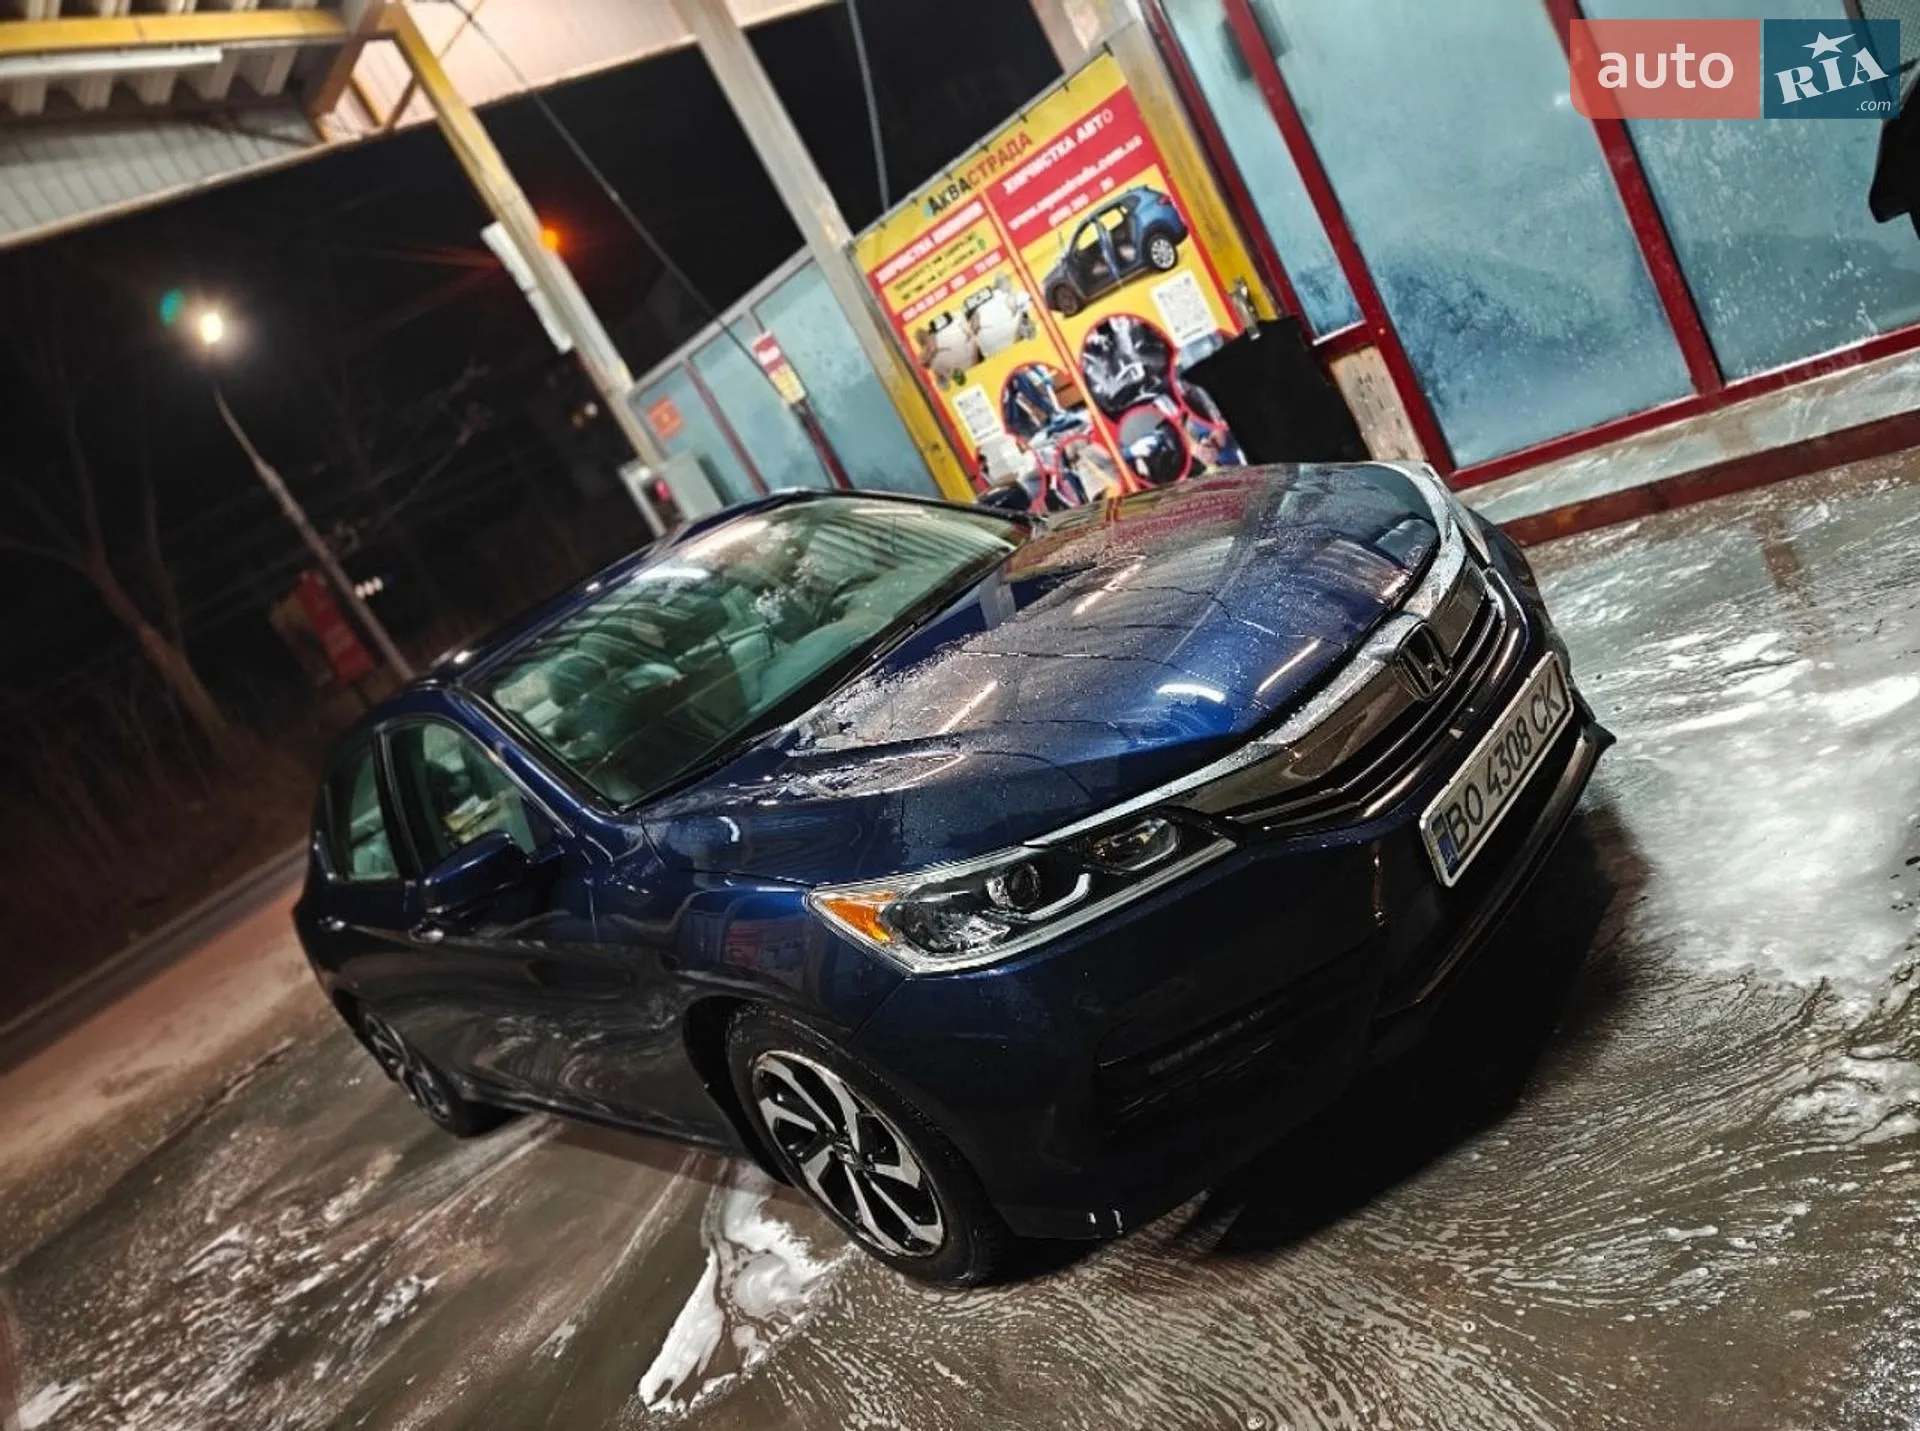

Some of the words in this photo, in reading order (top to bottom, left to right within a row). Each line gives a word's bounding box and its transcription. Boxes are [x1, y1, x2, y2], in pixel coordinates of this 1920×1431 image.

[1447, 785, 1484, 851] BO
[1485, 717, 1532, 797] 4308
[1530, 674, 1562, 736] CK
